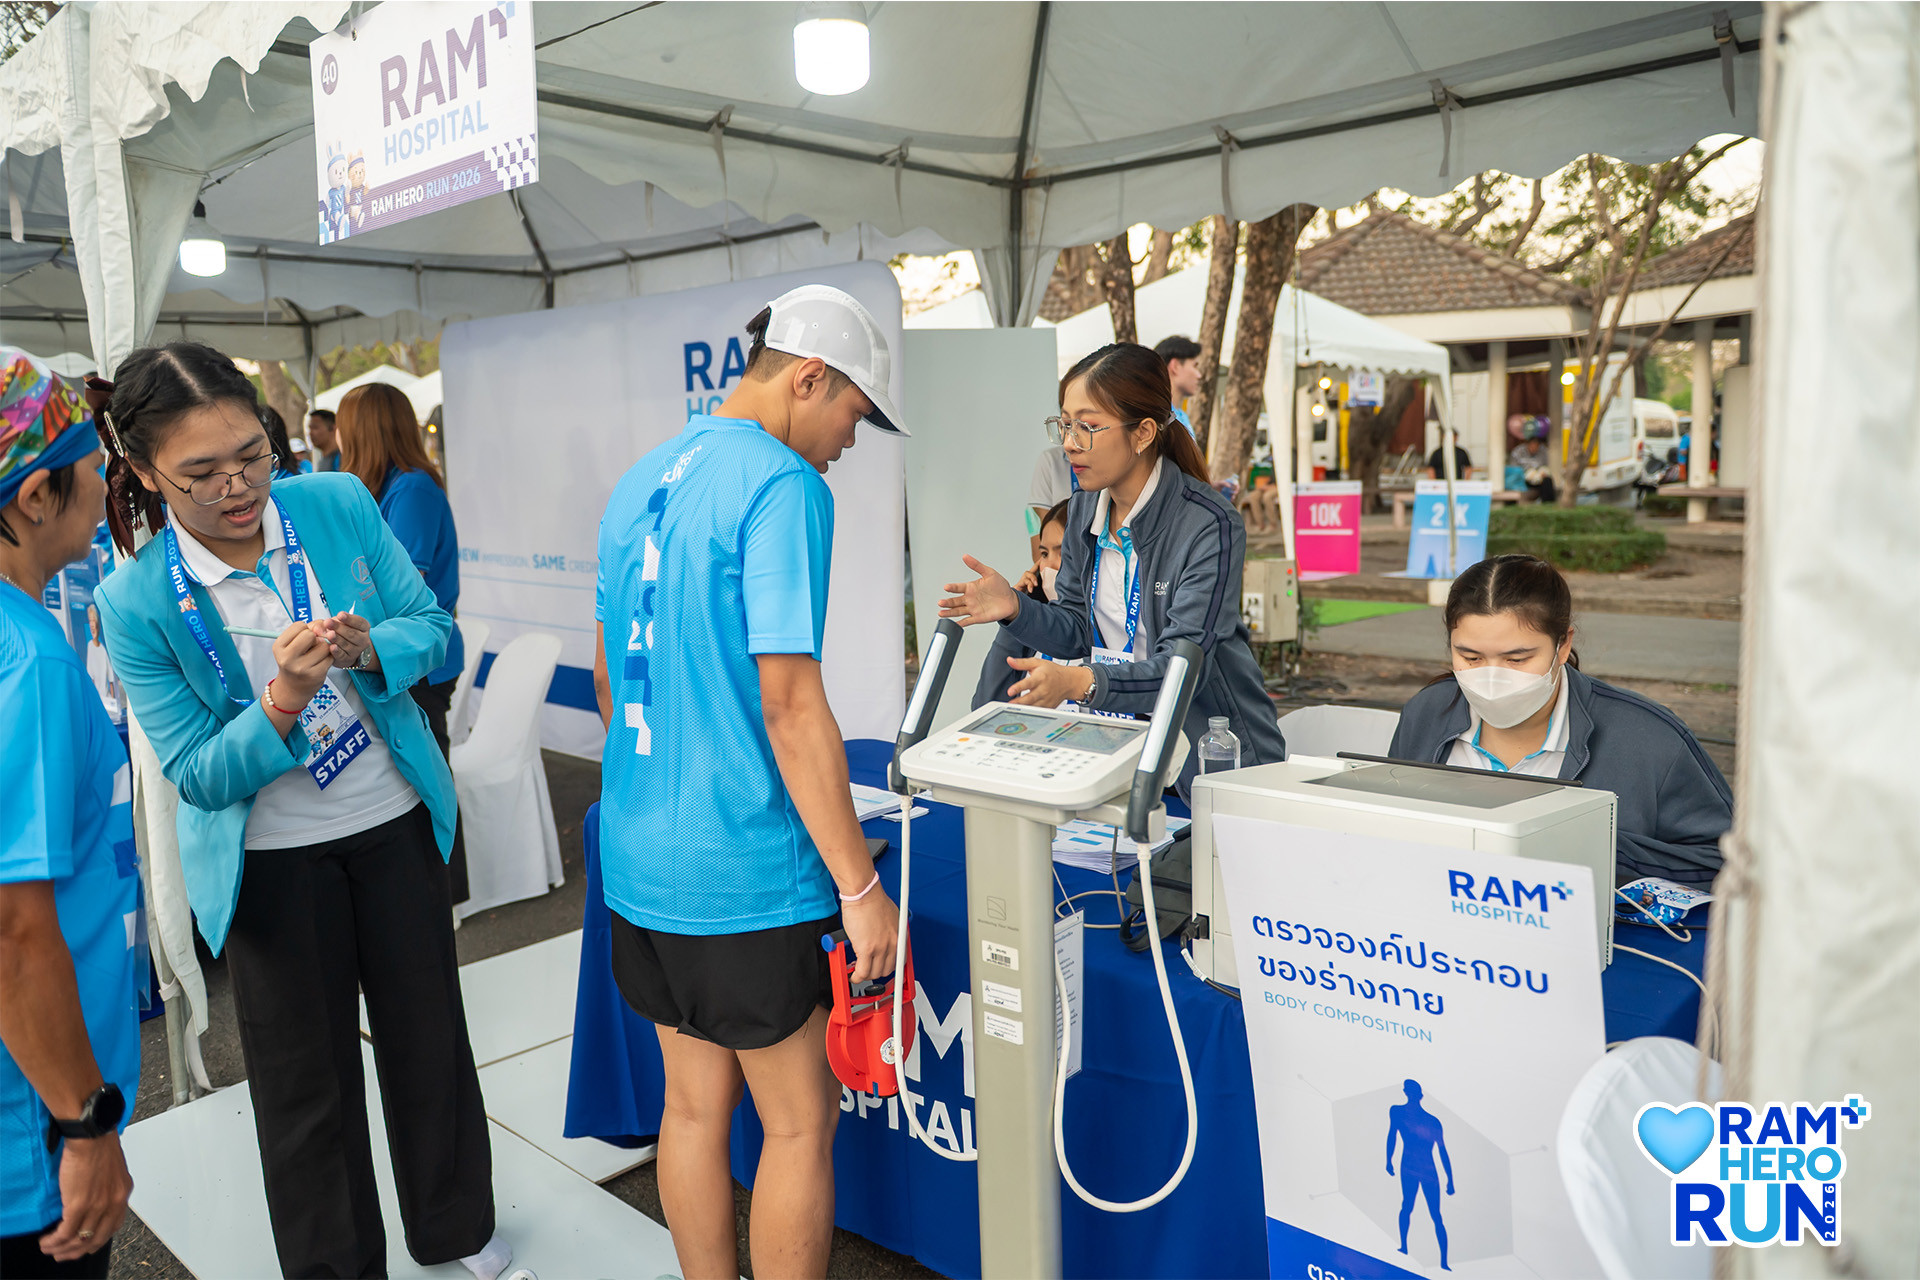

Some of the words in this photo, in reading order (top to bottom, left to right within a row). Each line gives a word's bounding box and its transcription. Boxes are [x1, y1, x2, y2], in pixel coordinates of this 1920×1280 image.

[322, 61, 337, 86] 40
[380, 14, 487, 128] RAM
[384, 100, 489, 166] HOSPITAL
[371, 194, 394, 217] RAM
[395, 184, 424, 209] HERO
[426, 178, 450, 200] RUN
[451, 166, 481, 193] 2026
[683, 336, 746, 392] RA
[1308, 502, 1342, 527] 10K
[1430, 502, 1470, 528] 2K
[168, 530, 178, 563] 2026
[284, 519, 298, 547] RUN
[170, 565, 187, 594] RUN
[532, 553, 567, 572] SAME
[293, 569, 307, 604] HERO
[1129, 592, 1142, 617] RAM
[188, 614, 213, 649] HERO
[315, 728, 366, 784] STAFF
[1448, 870, 1549, 913] RAM
[1452, 900, 1551, 930] HOSPITAL
[1252, 915, 1549, 994] ตรวจองค์ประกอบ
[1257, 955, 1445, 1015] ของร่างกาย
[1264, 990, 1308, 1013] BODY
[1313, 1003, 1433, 1043] COMPOSITION
